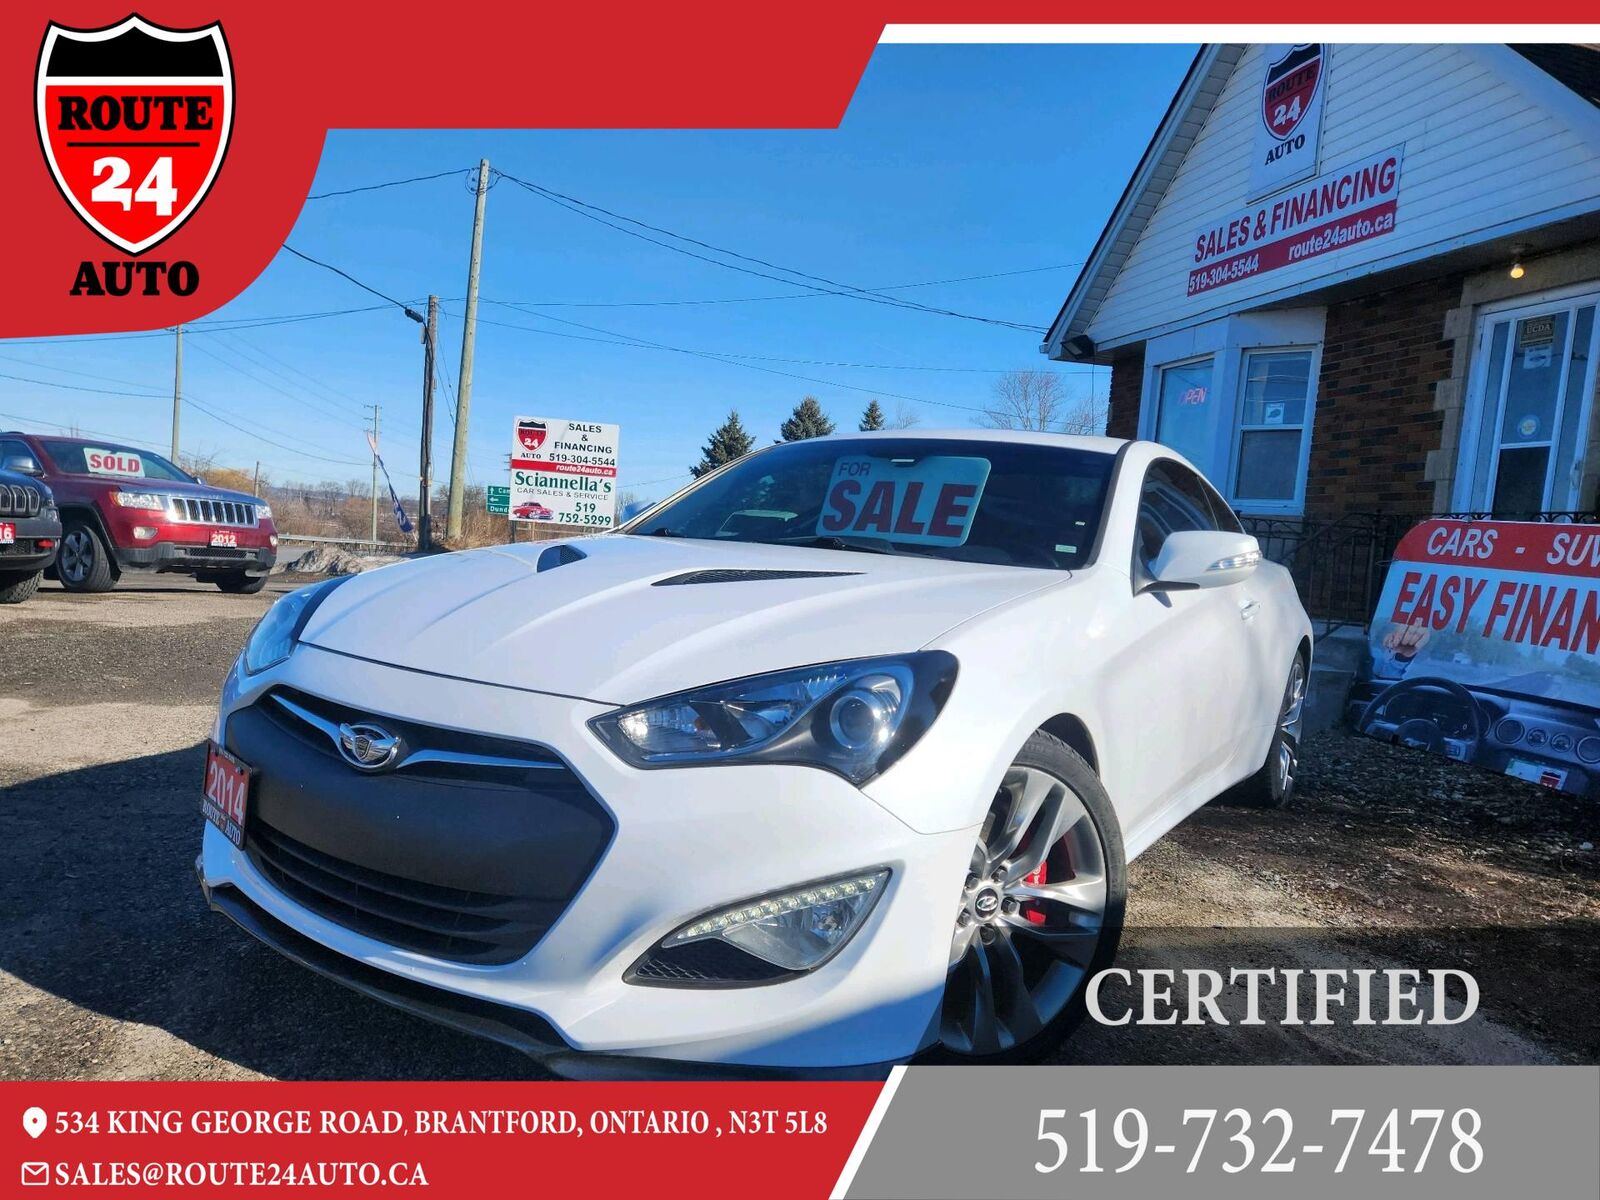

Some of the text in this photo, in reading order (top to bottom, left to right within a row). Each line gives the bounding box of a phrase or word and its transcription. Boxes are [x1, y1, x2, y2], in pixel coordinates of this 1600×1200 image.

[1267, 66, 1316, 102] ROUTE
[1273, 95, 1301, 127] 24
[1264, 134, 1306, 166] AUTO
[1194, 157, 1397, 263] SALES & FINANCING
[1188, 212, 1394, 293] 519-304-5544 route24auto.ca
[568, 423, 602, 433] SALES
[524, 438, 539, 448] 24
[554, 441, 613, 454] FINANCING
[90, 454, 140, 472] SOLD
[549, 453, 616, 466] 519-304-5544
[556, 465, 613, 476] route24auto.ca
[838, 461, 871, 477] FOR
[514, 471, 612, 493] Sciannella's
[536, 489, 563, 497] SALES
[574, 492, 609, 501] SERVICE
[575, 502, 596, 513] 519
[822, 479, 977, 538] SALE
[559, 512, 611, 526] 752-5299
[211, 533, 236, 544] 2012
[1426, 526, 1498, 560] CARS
[1390, 571, 1600, 655] EASY FINAN
[208, 761, 245, 825] 2014
[202, 799, 220, 825] ROUTE
[225, 819, 241, 846] AUTO
